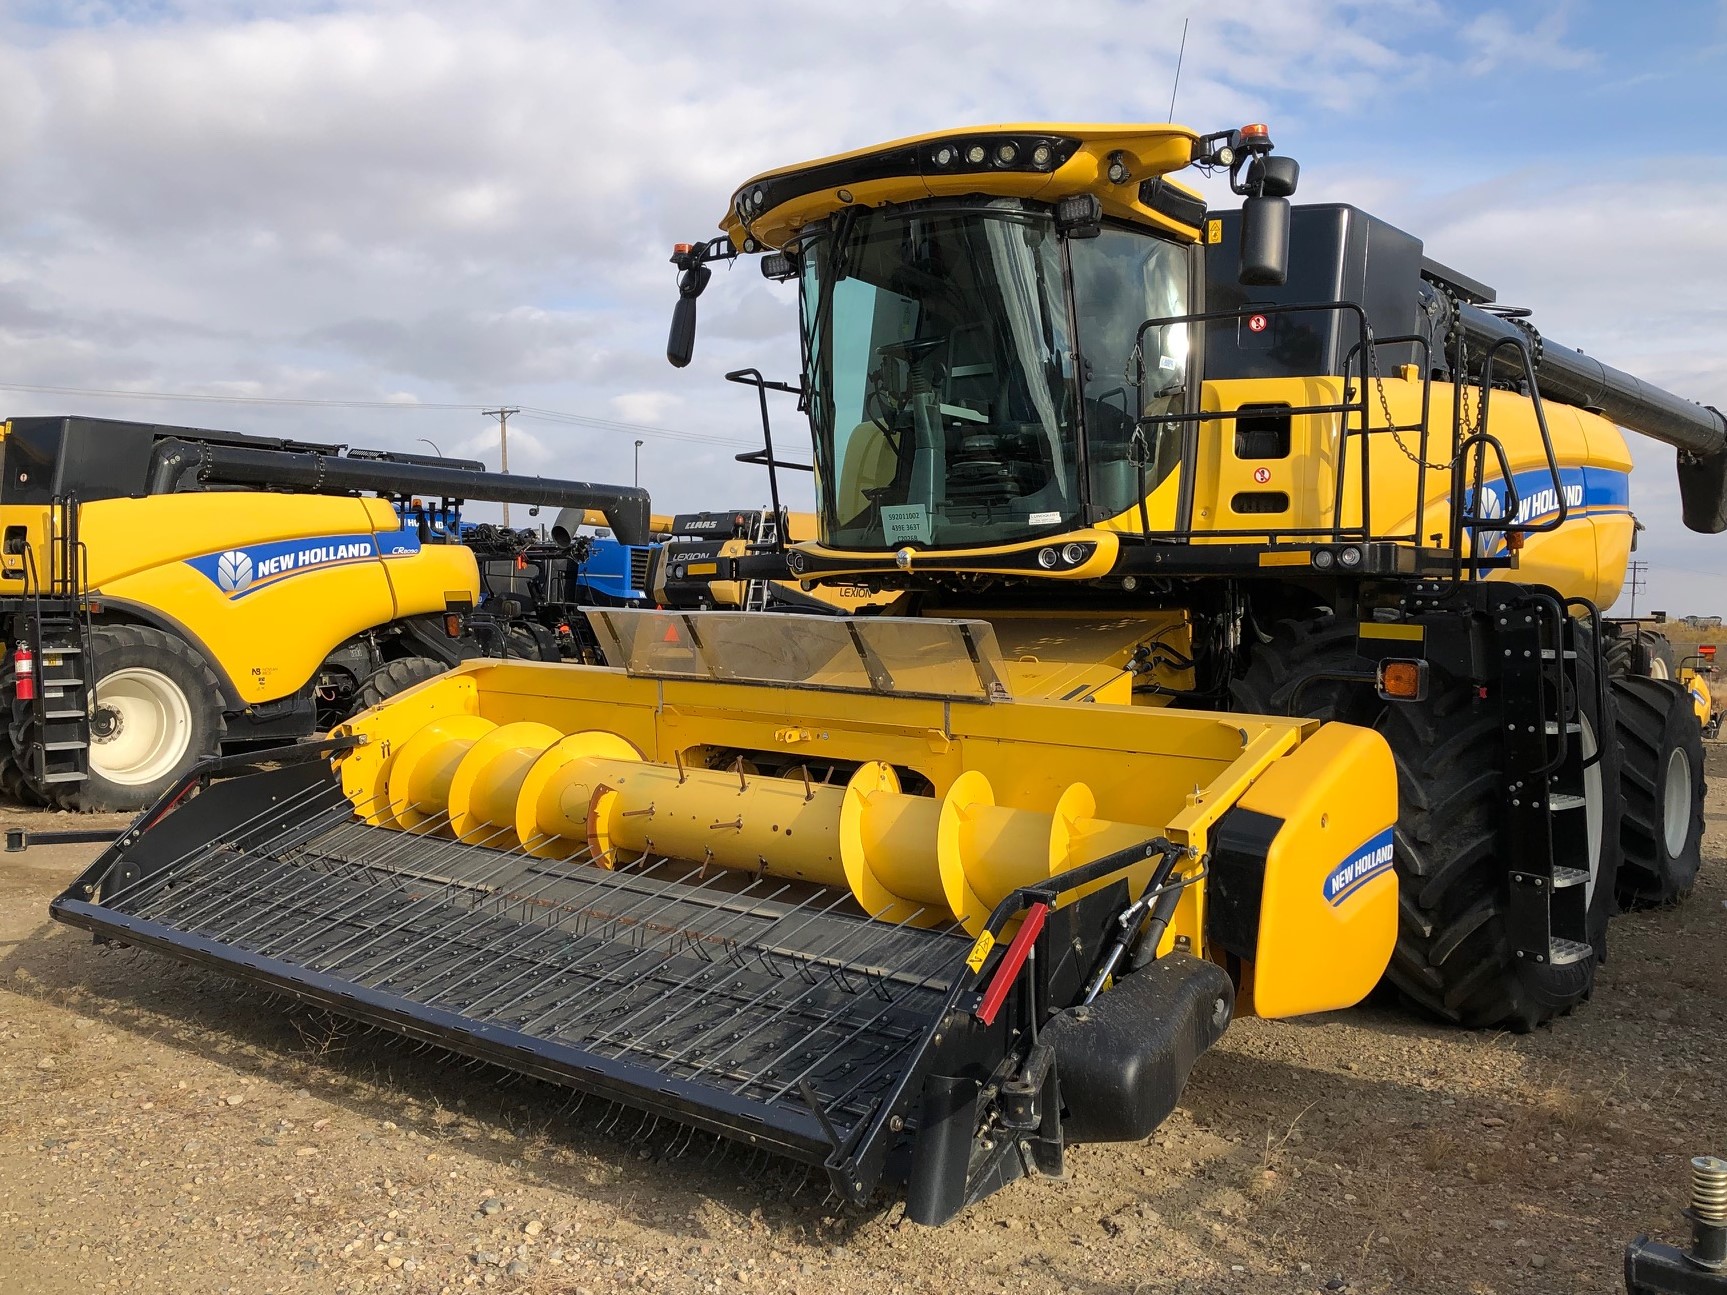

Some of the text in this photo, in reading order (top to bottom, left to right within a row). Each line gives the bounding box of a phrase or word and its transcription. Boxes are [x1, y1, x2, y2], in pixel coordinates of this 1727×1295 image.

[1532, 485, 1583, 517] HOLLND
[684, 521, 718, 530] CLAAS
[258, 543, 371, 578] NEW HOLLAND
[672, 552, 710, 561] LEXION
[839, 587, 872, 599] LEXION
[1331, 843, 1394, 895] NEW HOLLAND
